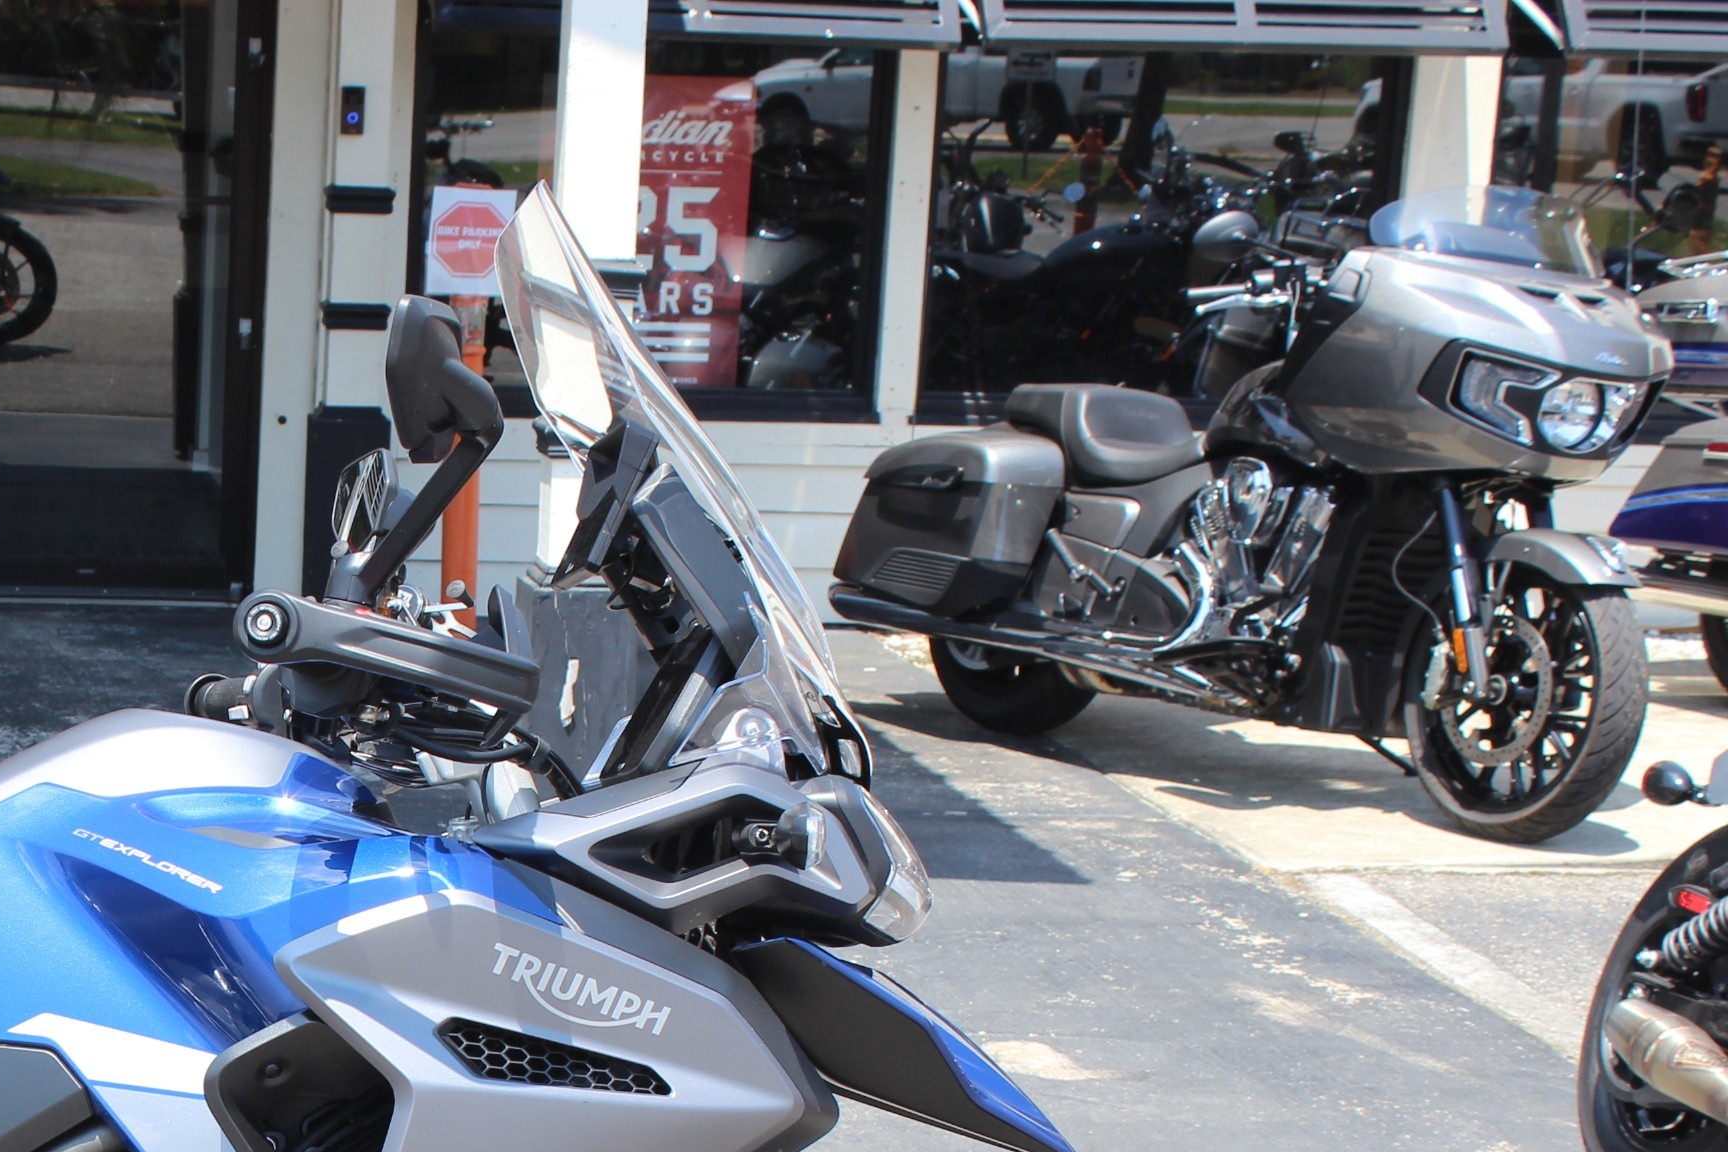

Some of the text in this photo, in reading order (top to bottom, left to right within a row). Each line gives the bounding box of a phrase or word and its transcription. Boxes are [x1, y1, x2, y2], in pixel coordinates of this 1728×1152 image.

[641, 110, 734, 146] dian
[437, 226, 503, 238] BIKE PARKIN
[458, 239, 482, 250] ONLY
[635, 282, 714, 316] ARS
[492, 942, 672, 1036] TRIUMPH
